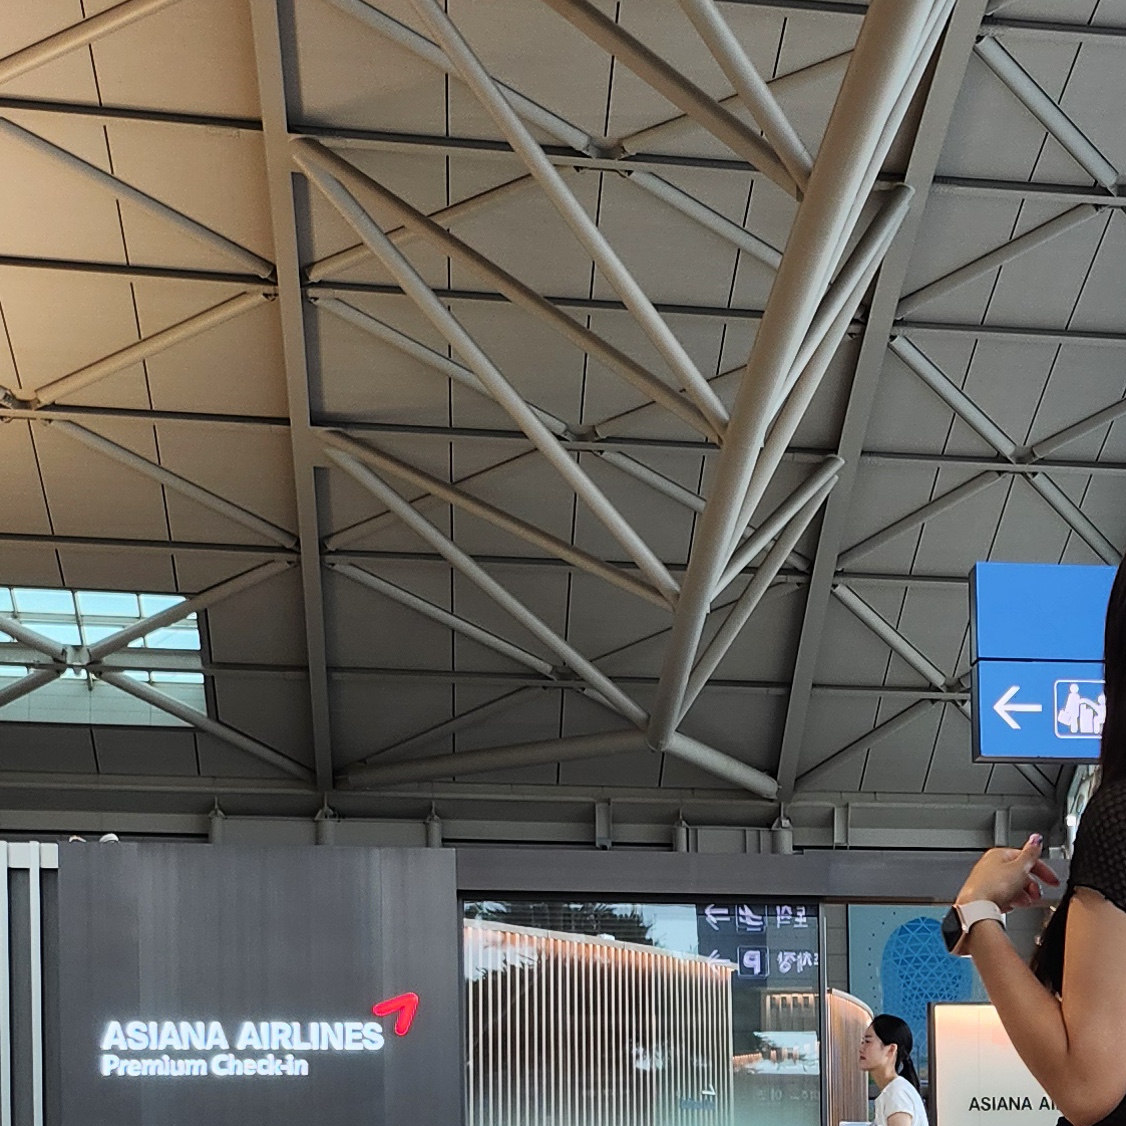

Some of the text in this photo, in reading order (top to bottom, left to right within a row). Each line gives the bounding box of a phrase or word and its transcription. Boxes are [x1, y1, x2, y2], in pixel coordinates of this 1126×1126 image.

[100, 1020, 384, 1051] ASIANA AIRLINES
[101, 1054, 308, 1077] Premium Check-in
[968, 1096, 1060, 1111] ASIANA AI
